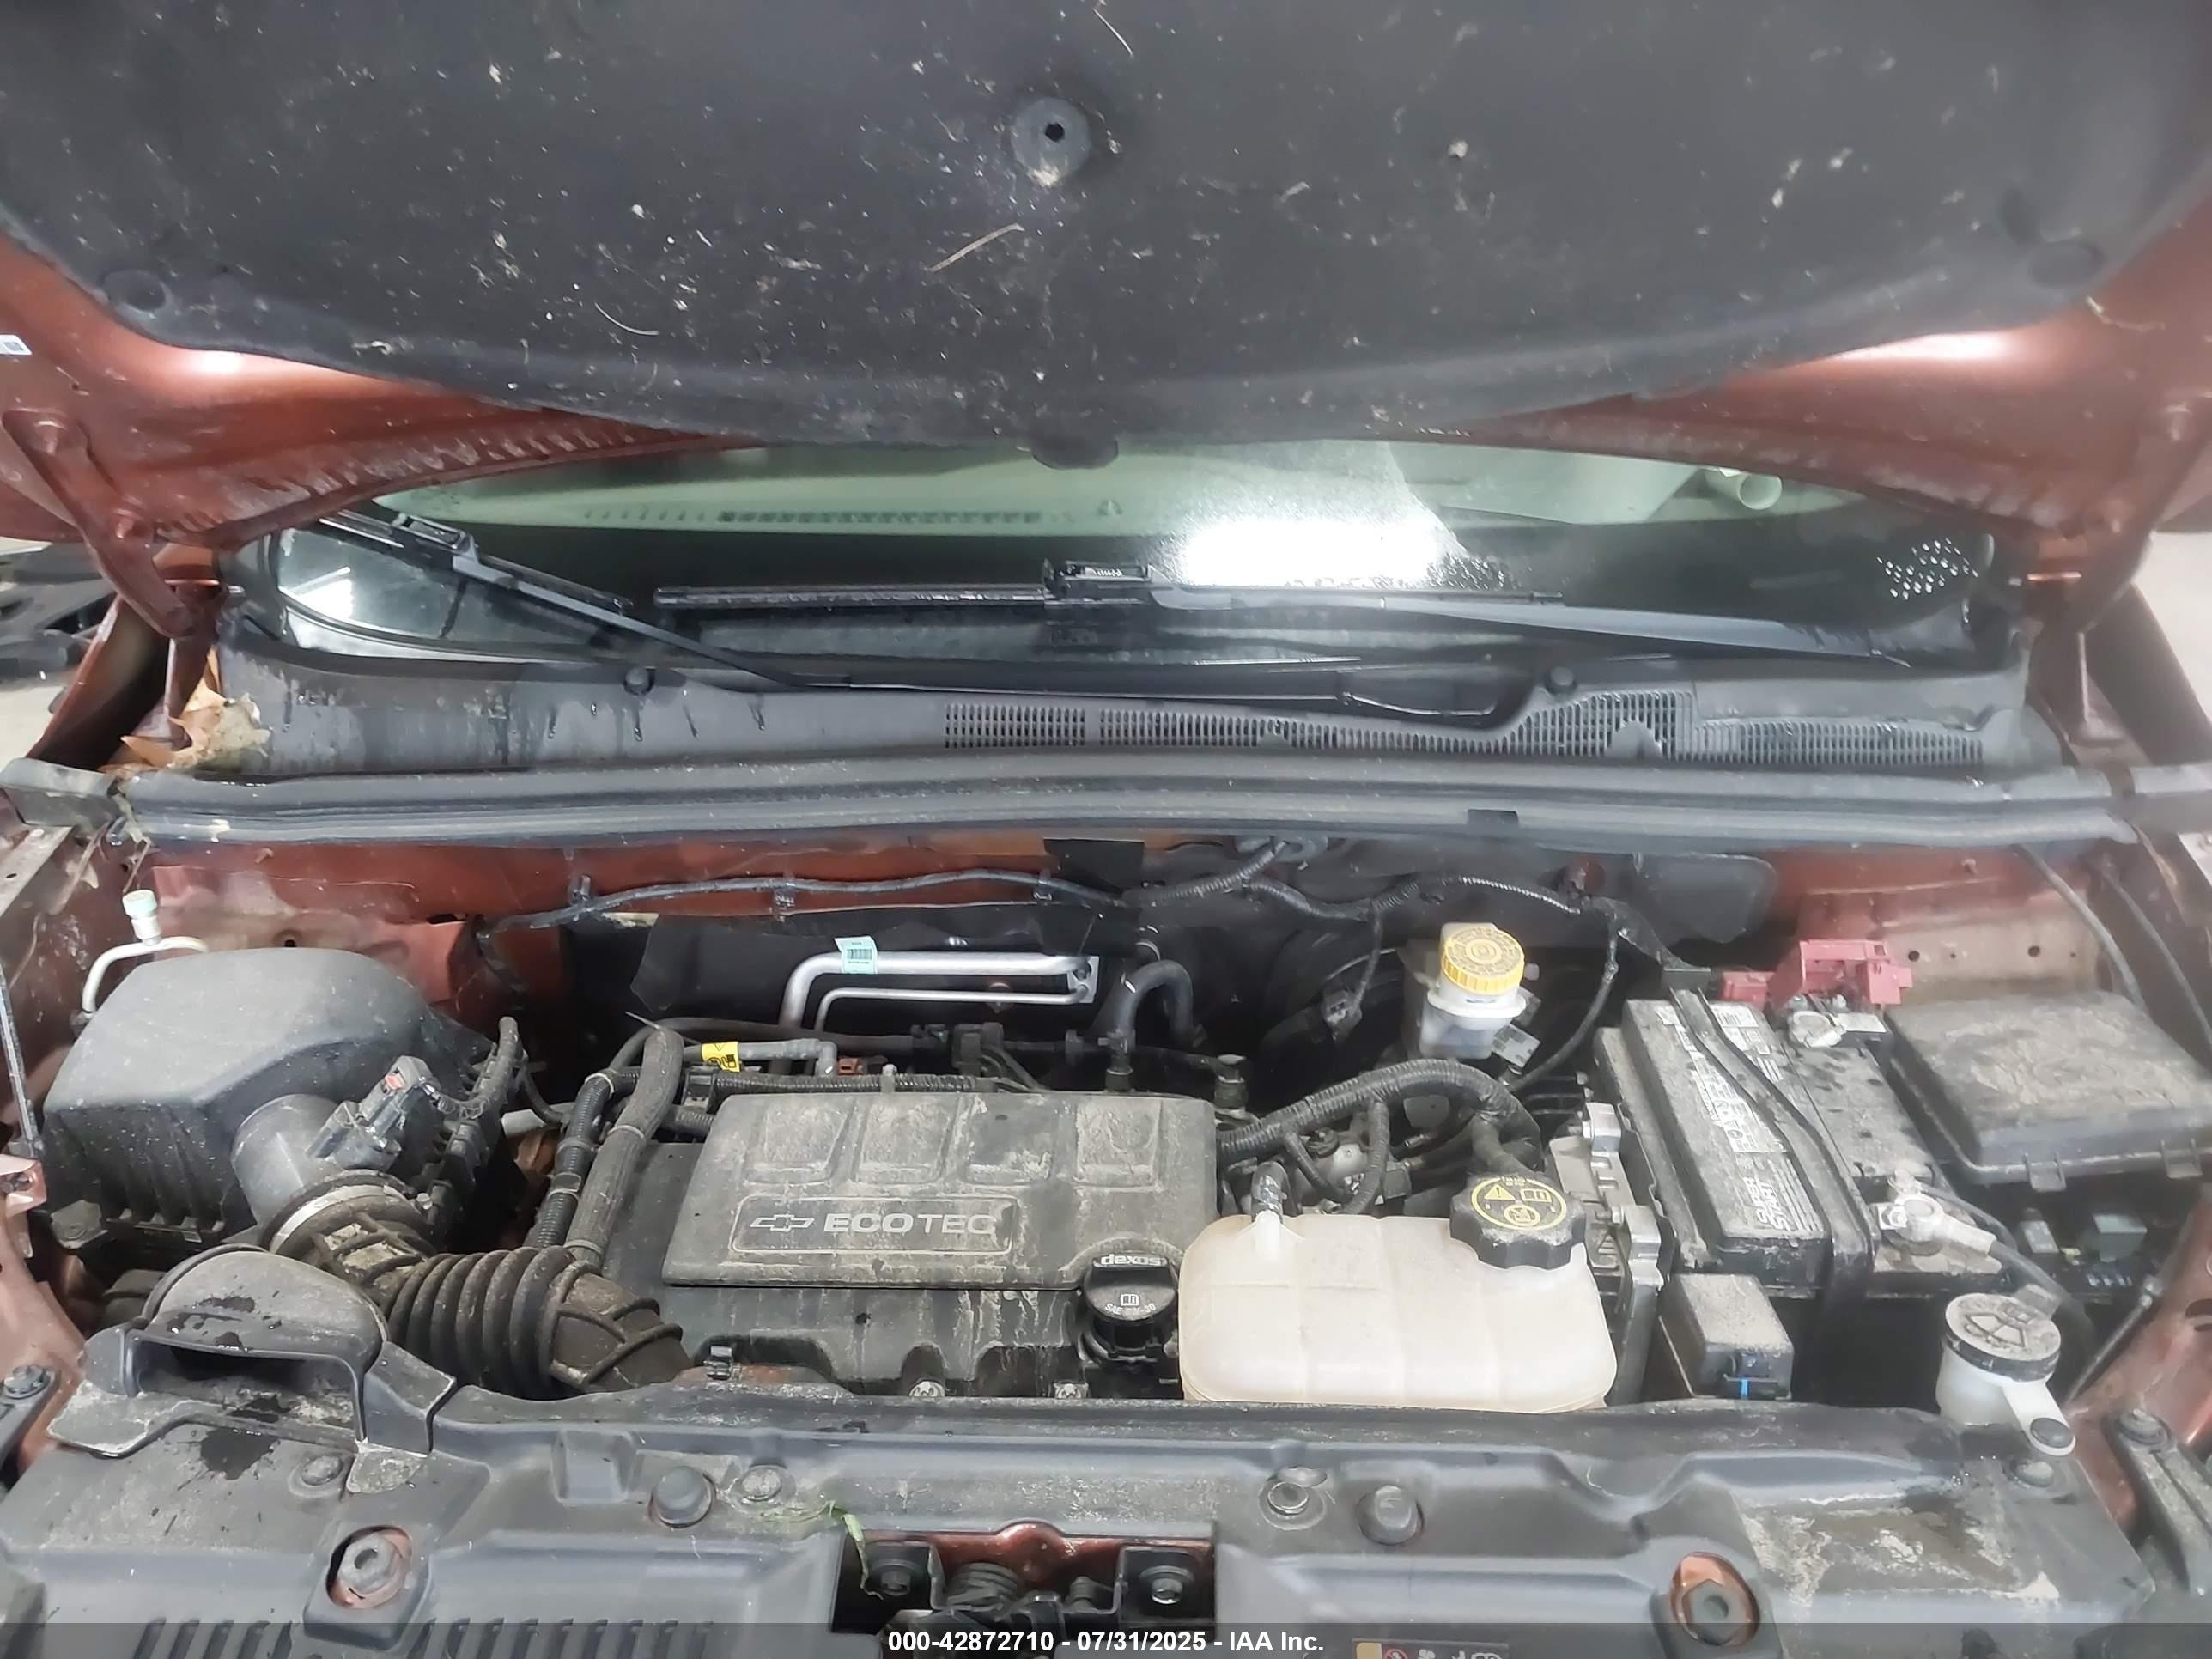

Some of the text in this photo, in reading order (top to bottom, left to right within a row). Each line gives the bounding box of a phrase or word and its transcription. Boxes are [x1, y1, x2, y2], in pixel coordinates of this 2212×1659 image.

[1754, 1182, 1790, 1231] START
[823, 1213, 997, 1234] ECOTEC
[1100, 1253, 1162, 1267] dexos
[1104, 1303, 1123, 1316] SAE
